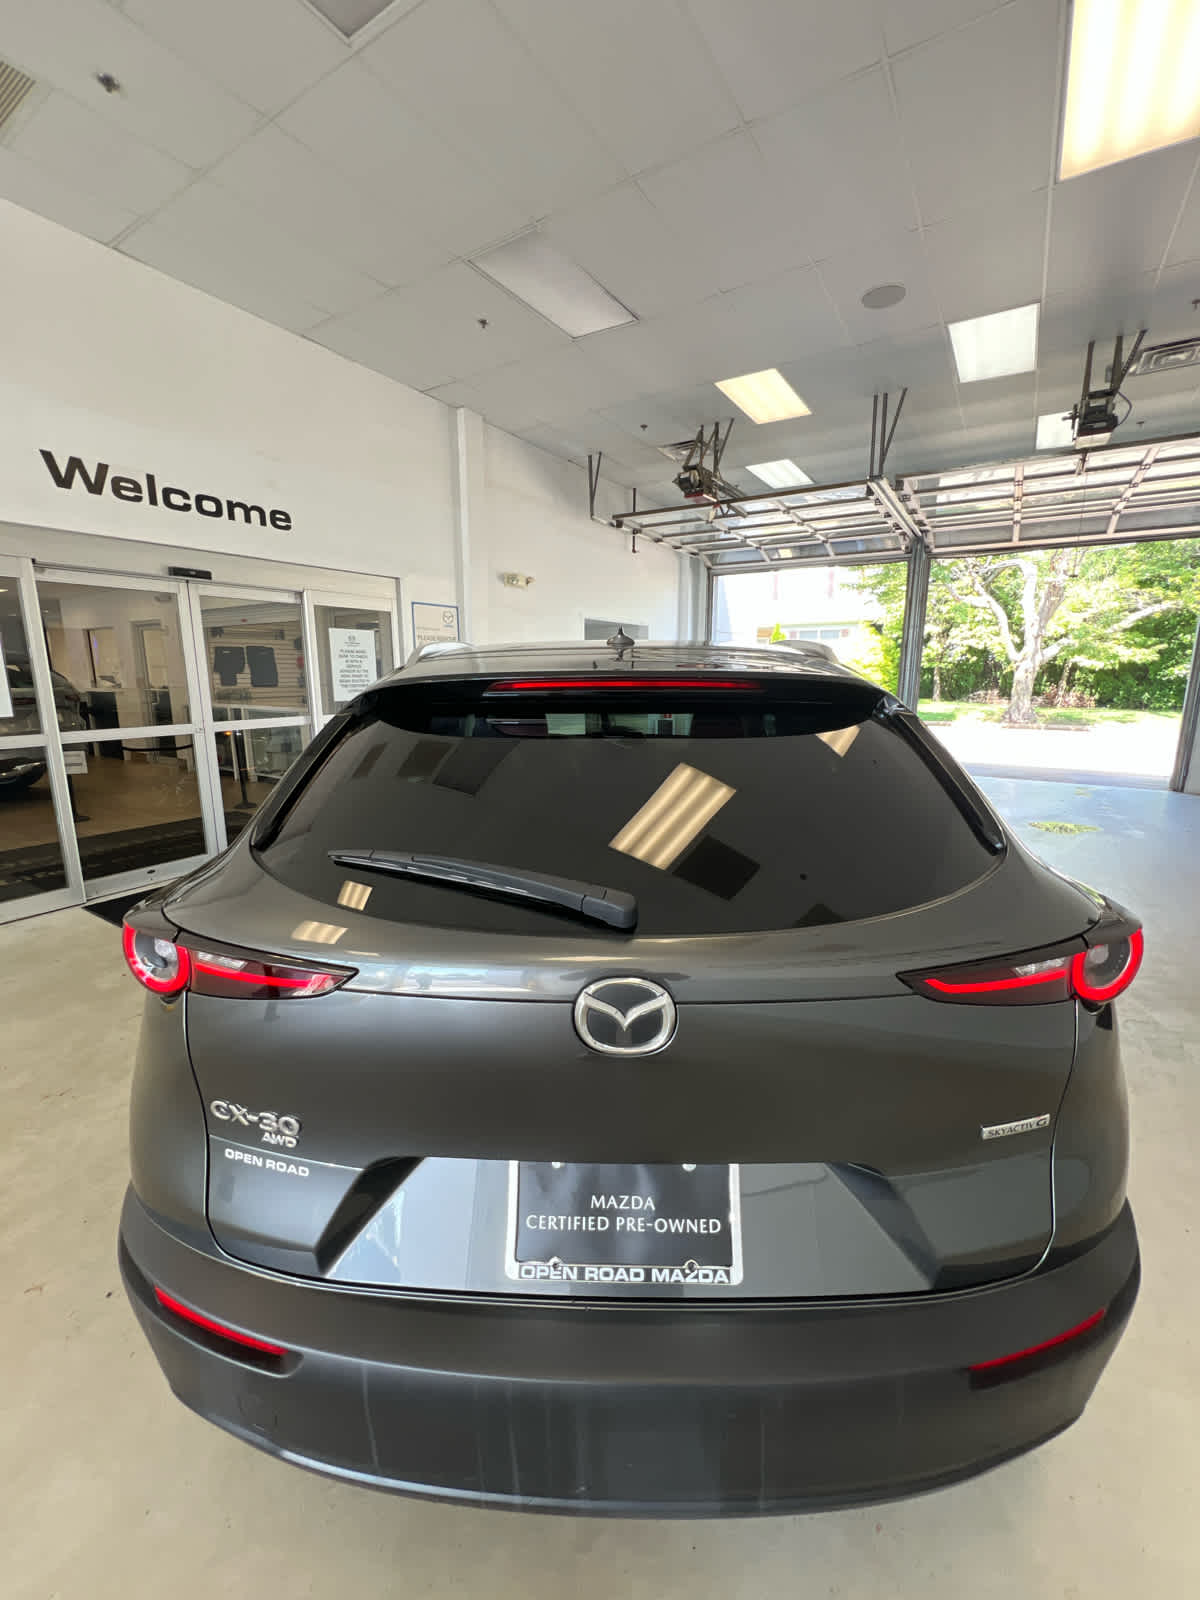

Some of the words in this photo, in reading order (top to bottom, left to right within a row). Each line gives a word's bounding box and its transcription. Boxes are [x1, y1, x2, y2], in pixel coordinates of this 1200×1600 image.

[39, 449, 292, 531] Welcome
[209, 1100, 301, 1136] CX-30
[261, 1131, 298, 1148] AWD
[224, 1148, 263, 1167] OPEN
[265, 1159, 310, 1177] ROAD
[590, 1195, 656, 1211] MAZDA
[525, 1215, 609, 1231] CERTIFIED
[616, 1216, 722, 1234] PRE-OWNED
[520, 1266, 577, 1280] OPEN
[584, 1267, 645, 1282] ROAD
[651, 1268, 730, 1283] MAZDA
